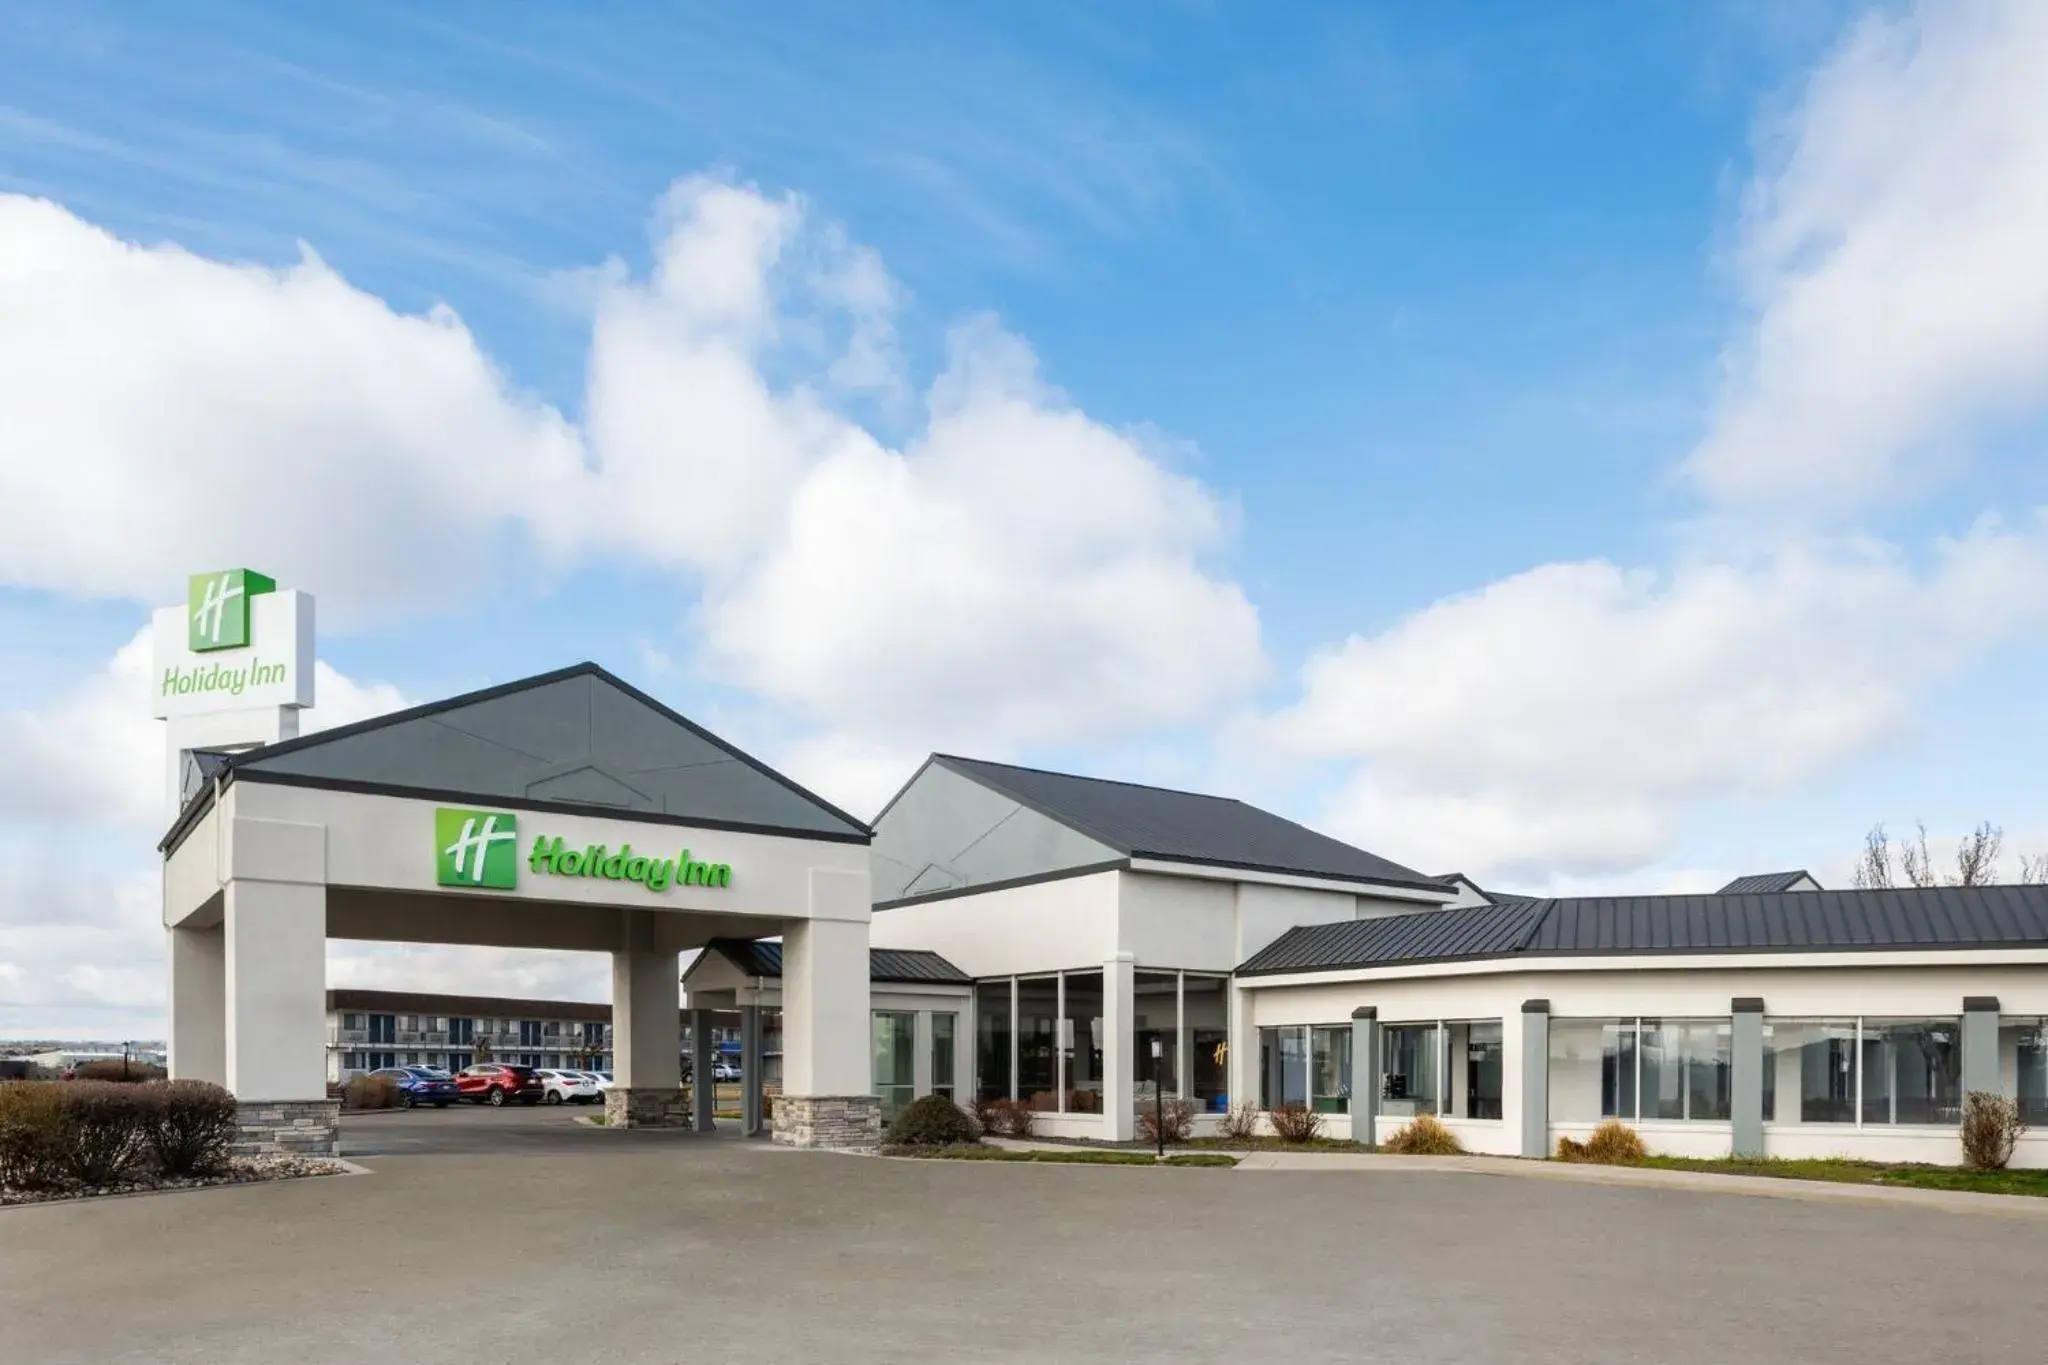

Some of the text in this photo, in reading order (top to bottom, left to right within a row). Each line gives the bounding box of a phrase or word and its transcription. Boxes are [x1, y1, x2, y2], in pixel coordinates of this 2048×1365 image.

[194, 574, 244, 643] H
[163, 657, 286, 697] Holiday Inn
[445, 815, 516, 882] H
[528, 835, 732, 892] Holiday Inn
